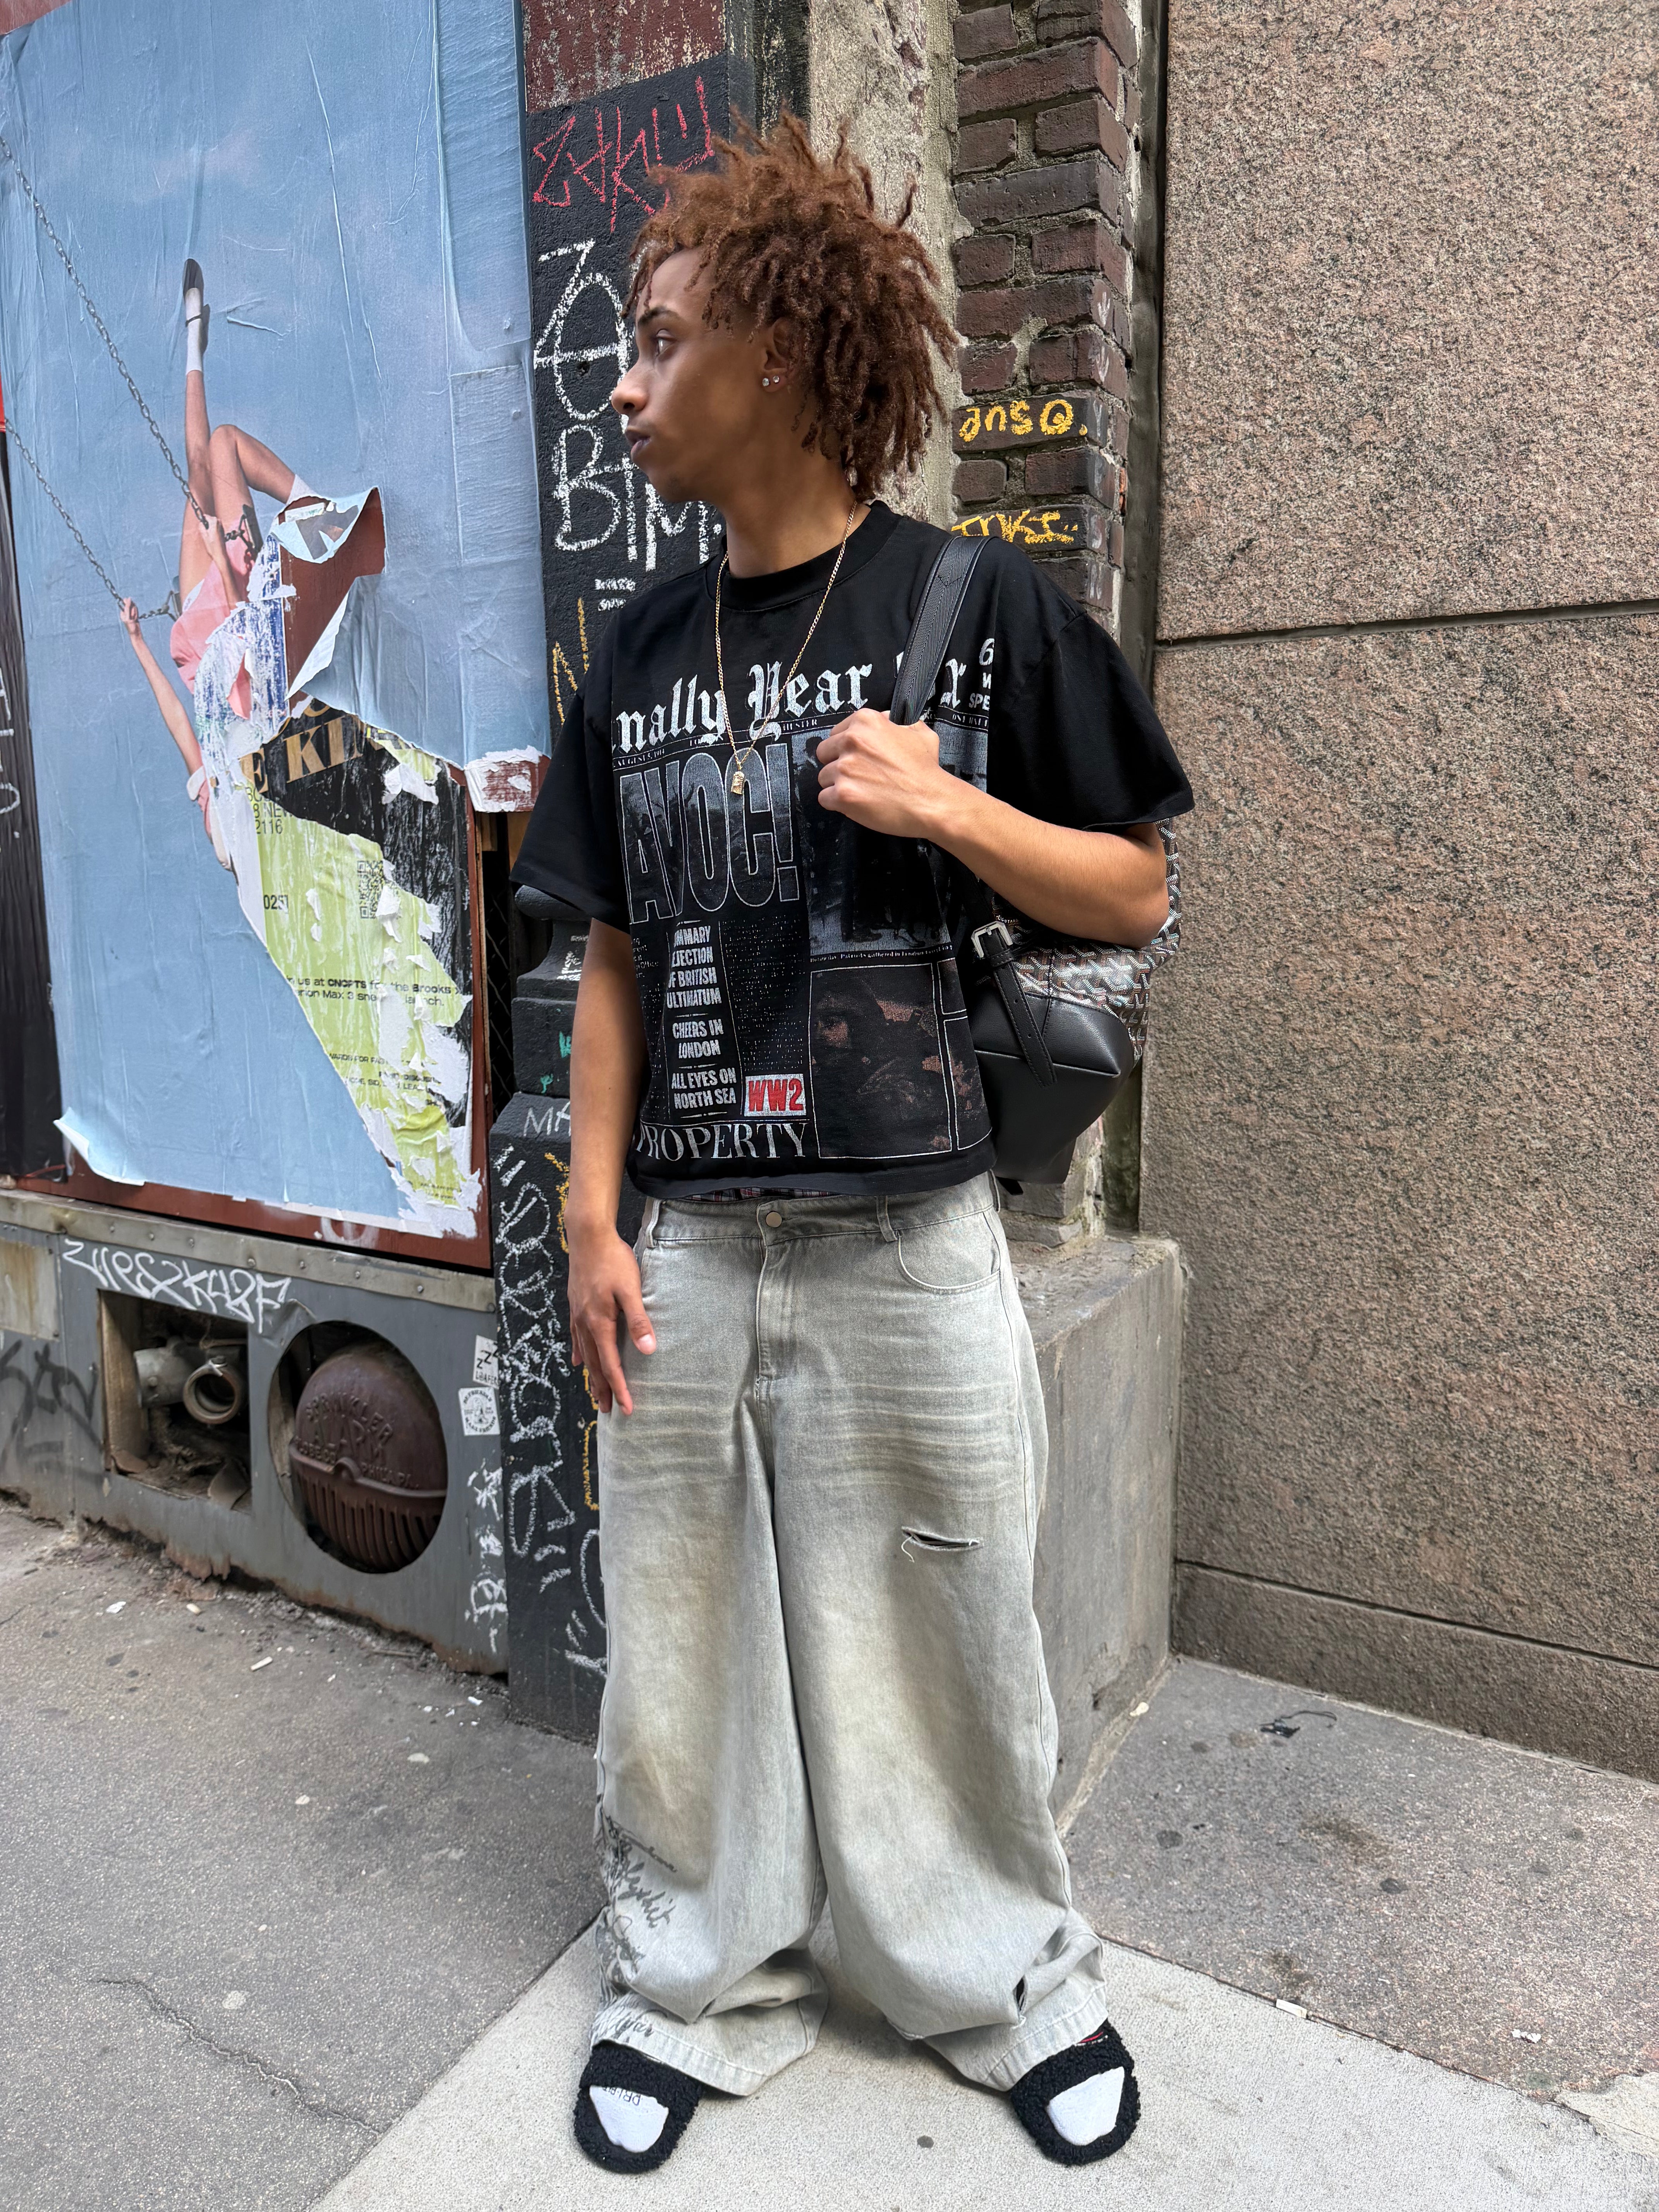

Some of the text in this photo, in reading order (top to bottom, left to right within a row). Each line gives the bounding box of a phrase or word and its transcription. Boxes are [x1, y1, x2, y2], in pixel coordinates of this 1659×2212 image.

[314, 977, 325, 987] at
[678, 967, 717, 988] BRITISH
[667, 988, 722, 1009] ULTIMATUM
[672, 1018, 724, 1039] CHEERS IN
[678, 1039, 721, 1059] LONDON
[671, 1068, 737, 1089] ALL EYES ON
[674, 1087, 737, 1109] NORTH SEA
[749, 1078, 805, 1112] WW2
